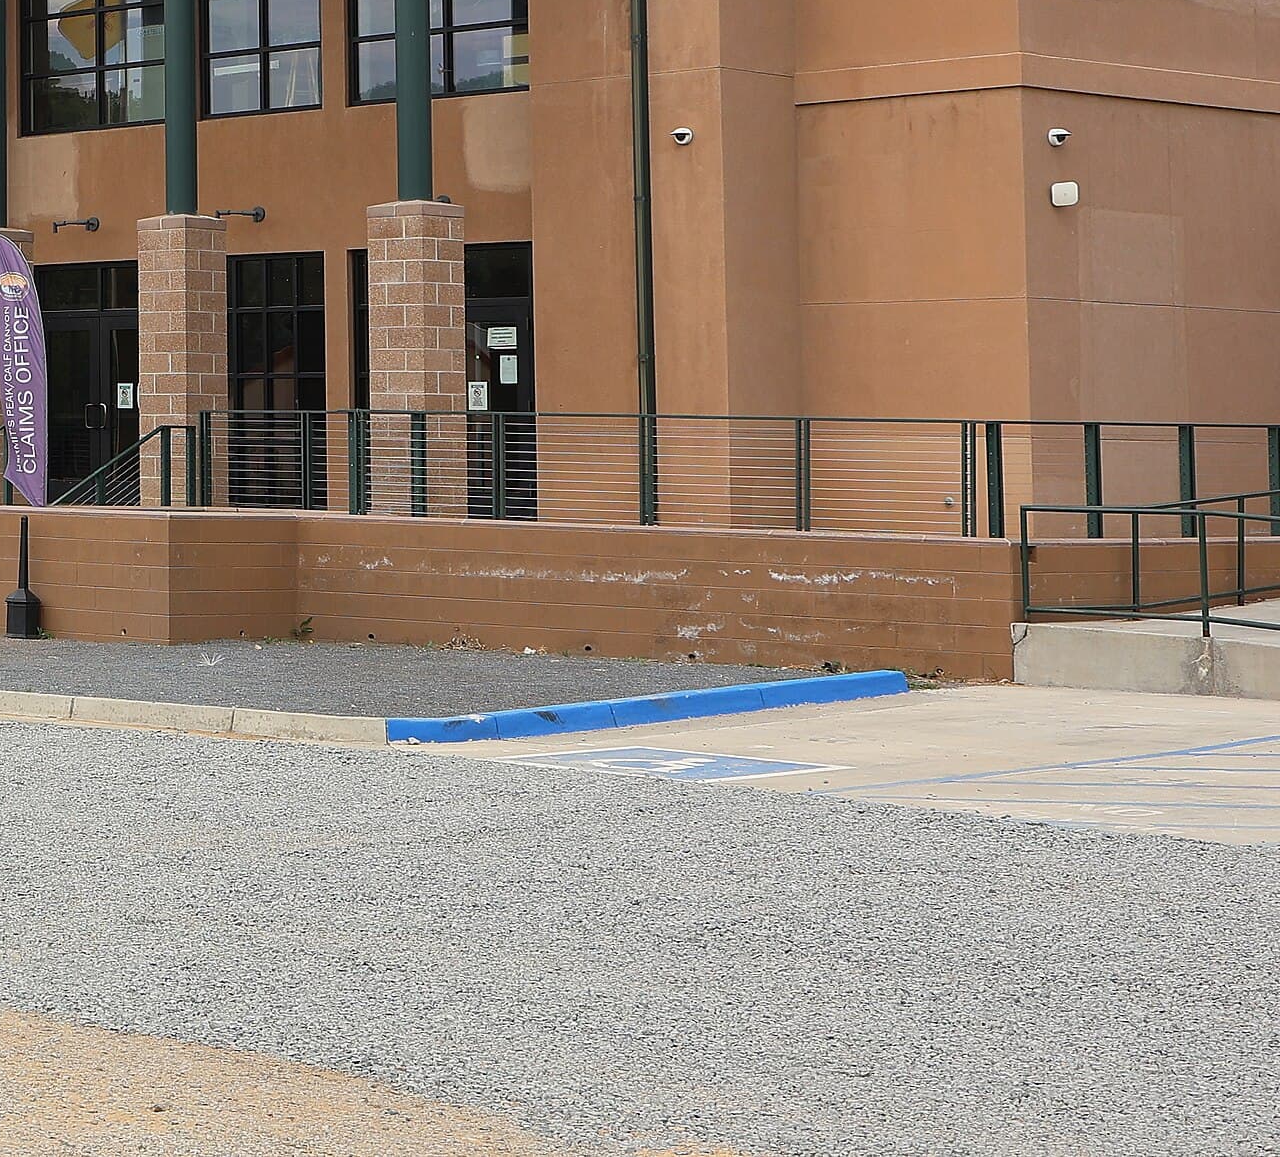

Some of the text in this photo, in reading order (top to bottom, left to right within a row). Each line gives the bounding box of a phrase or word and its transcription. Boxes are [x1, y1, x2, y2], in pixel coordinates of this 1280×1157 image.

[3, 305, 12, 351] CANYON
[13, 305, 32, 384] OFFICE
[17, 390, 37, 474] CLAIMS
